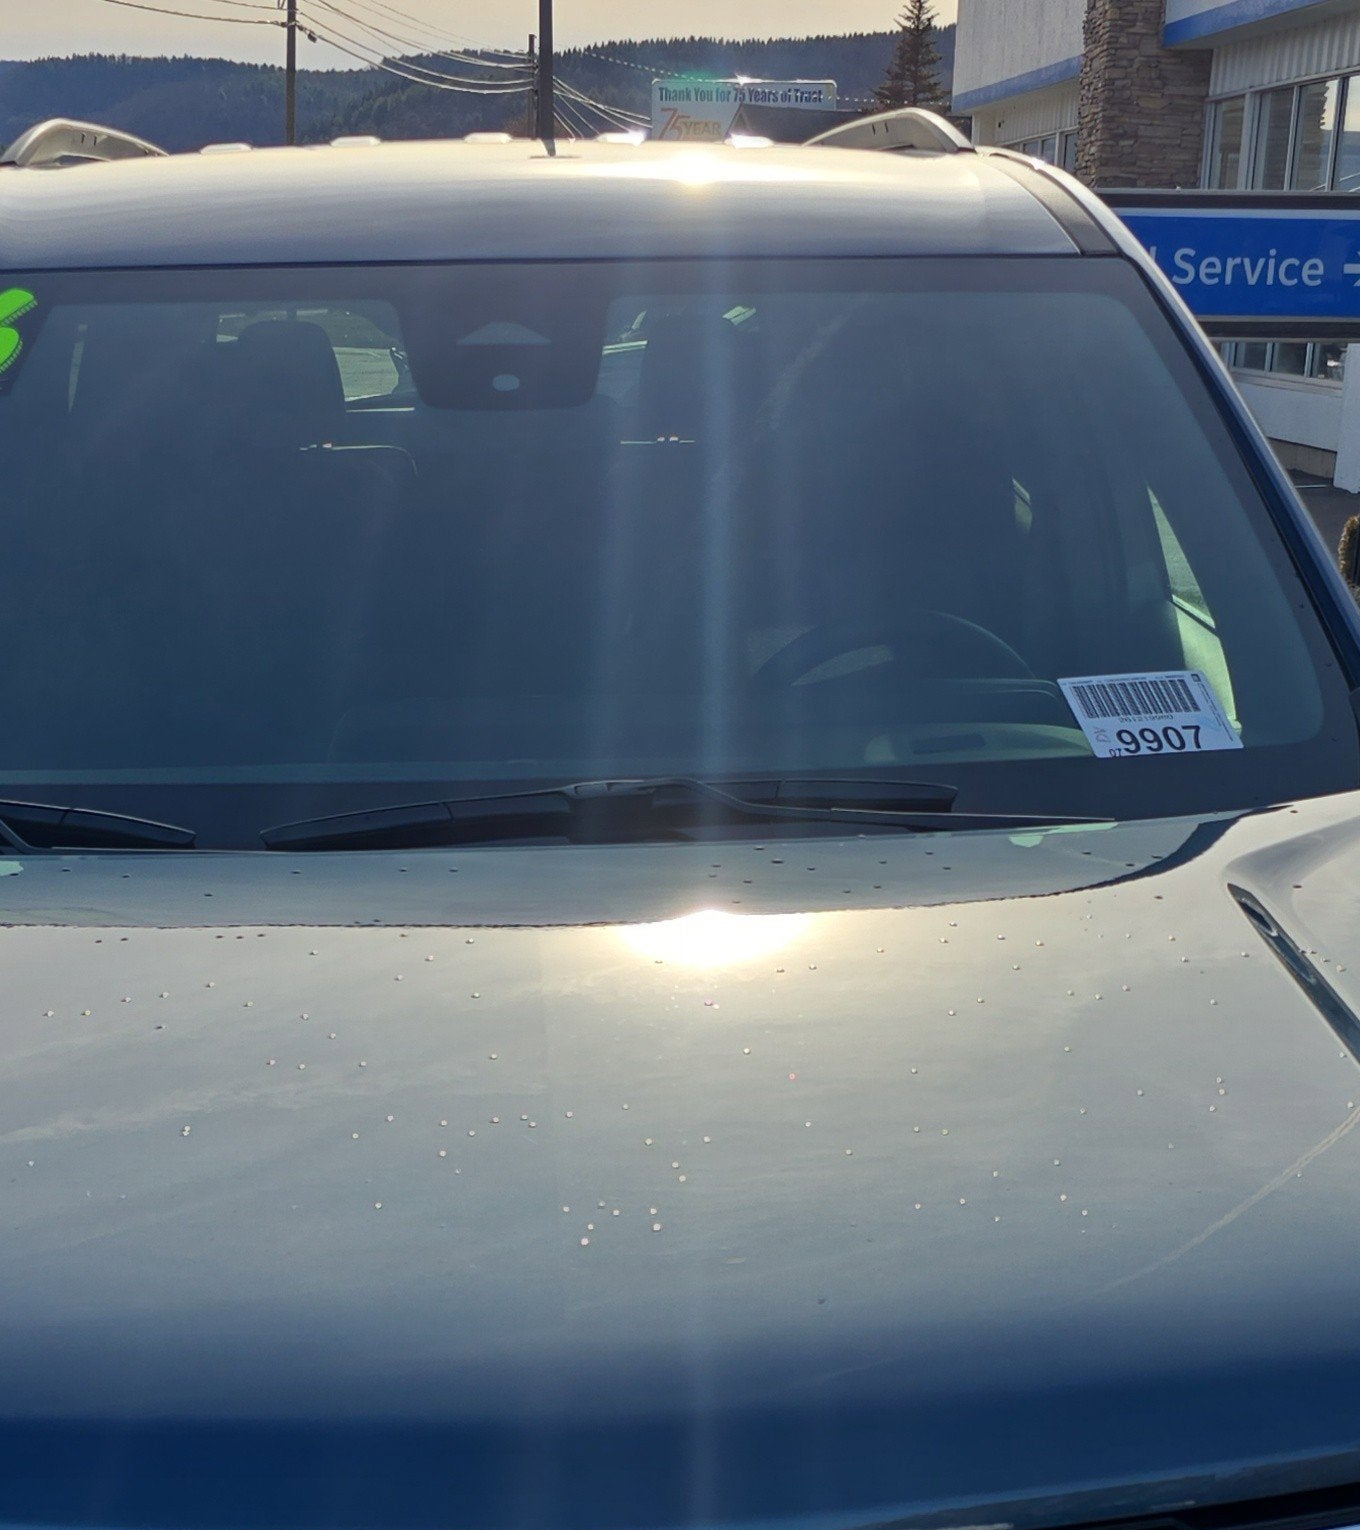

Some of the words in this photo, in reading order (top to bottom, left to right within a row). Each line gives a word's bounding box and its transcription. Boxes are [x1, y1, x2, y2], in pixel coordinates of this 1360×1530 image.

[658, 87, 691, 102] Thank
[693, 87, 713, 102] You
[715, 87, 731, 103] for
[748, 87, 779, 103] Years
[780, 88, 792, 103] of
[793, 88, 823, 103] Trust
[1172, 247, 1325, 287] Service
[1115, 724, 1202, 754] 9907
